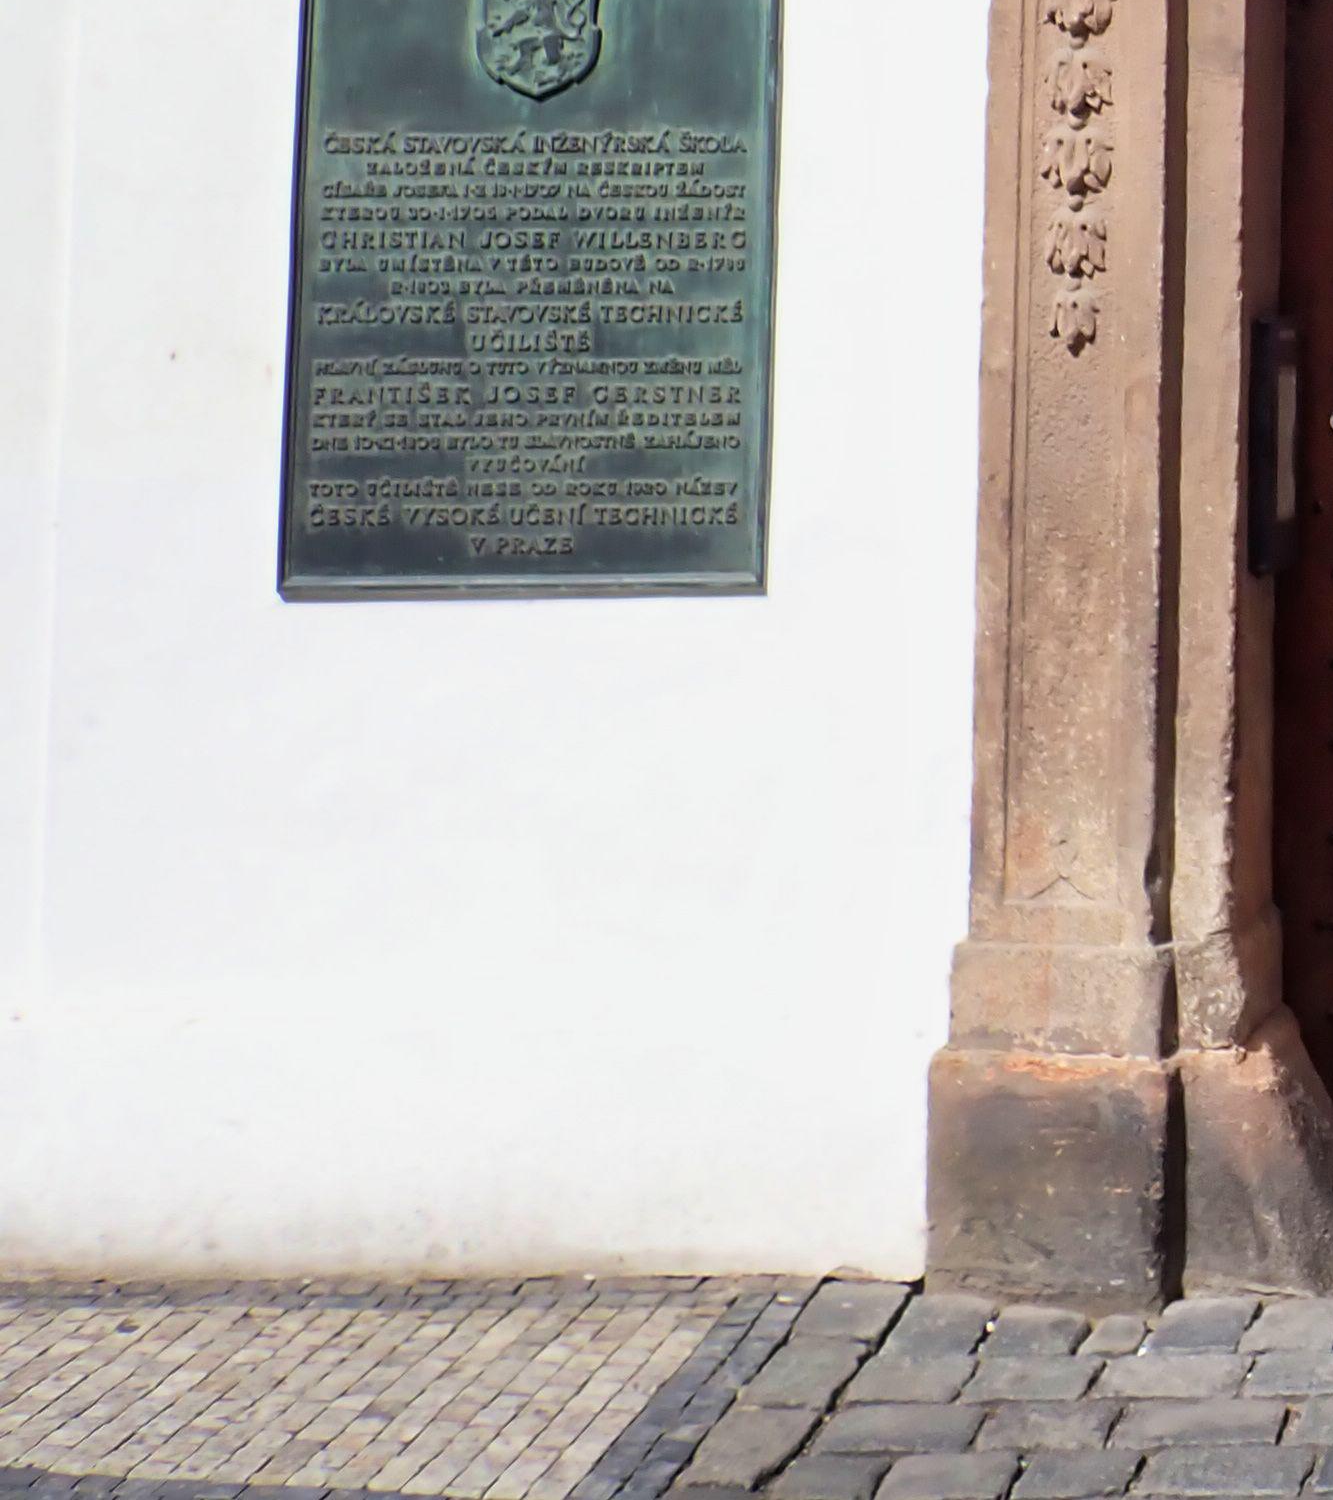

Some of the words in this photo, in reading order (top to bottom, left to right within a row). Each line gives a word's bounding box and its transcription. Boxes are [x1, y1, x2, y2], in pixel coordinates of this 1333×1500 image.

[323, 131, 396, 154] ČESKÁ
[403, 131, 526, 154] STAVOVSKÁ
[532, 130, 671, 154] INŽENÝRSKÁ
[678, 132, 748, 154] ŠKOLA
[567, 184, 591, 198] NA
[505, 206, 568, 221] PODAL
[320, 230, 465, 250] CHRISTIAN
[480, 230, 561, 250] JOSEF
[575, 230, 747, 250] WILLENBERG
[319, 257, 367, 272] BYLA
[490, 258, 500, 271] V
[507, 253, 558, 272] TÉTO
[656, 257, 681, 271] OD
[458, 280, 506, 295] BYLA
[649, 280, 675, 295] NA
[317, 300, 456, 325] KRÁLOVSKÉ
[466, 301, 591, 325] STAVOVSKÉ
[600, 300, 744, 324] TECHNICKÉ
[470, 329, 591, 352] UČILIŠTĚ
[313, 382, 471, 405] FRANTIŠEK
[485, 385, 577, 405] JOSEF
[592, 385, 742, 405] GERSTNER
[309, 483, 359, 498] TOTO
[366, 479, 458, 497] UČILIŠTĚ
[467, 482, 522, 497] NESE
[530, 482, 557, 497] OD
[564, 482, 618, 497] ROKU
[309, 503, 391, 526] ČESKÉ
[405, 502, 501, 526] VYSOKÉ
[509, 502, 587, 526] UČENÍ
[592, 502, 739, 526] TECHNICKÉ
[469, 537, 487, 554] V
[495, 537, 575, 555] PRAZE
